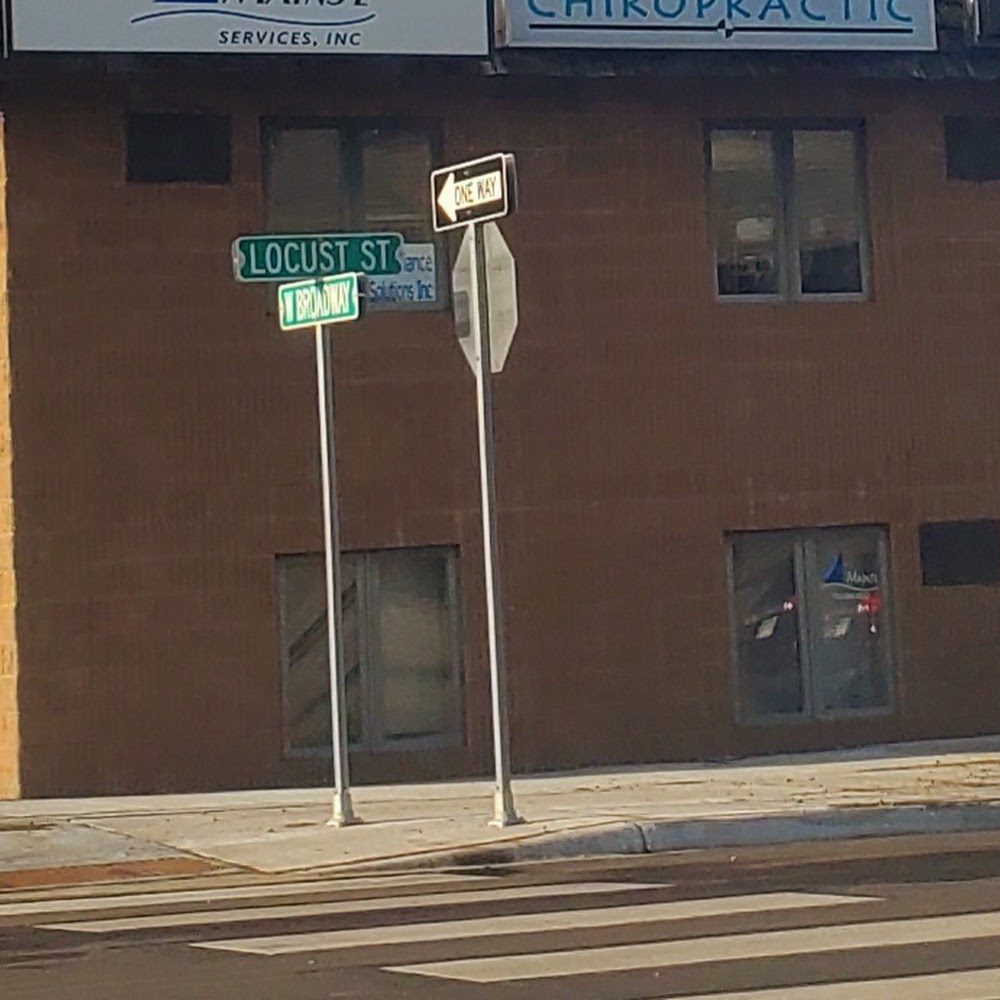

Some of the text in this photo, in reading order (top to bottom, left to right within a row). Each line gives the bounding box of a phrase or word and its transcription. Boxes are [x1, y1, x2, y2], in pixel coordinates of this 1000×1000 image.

[218, 30, 361, 46] SERVICES, INC
[454, 175, 497, 207] ONE WAY
[250, 240, 391, 274] LOCUST ST
[295, 279, 350, 320] BROADWAY
